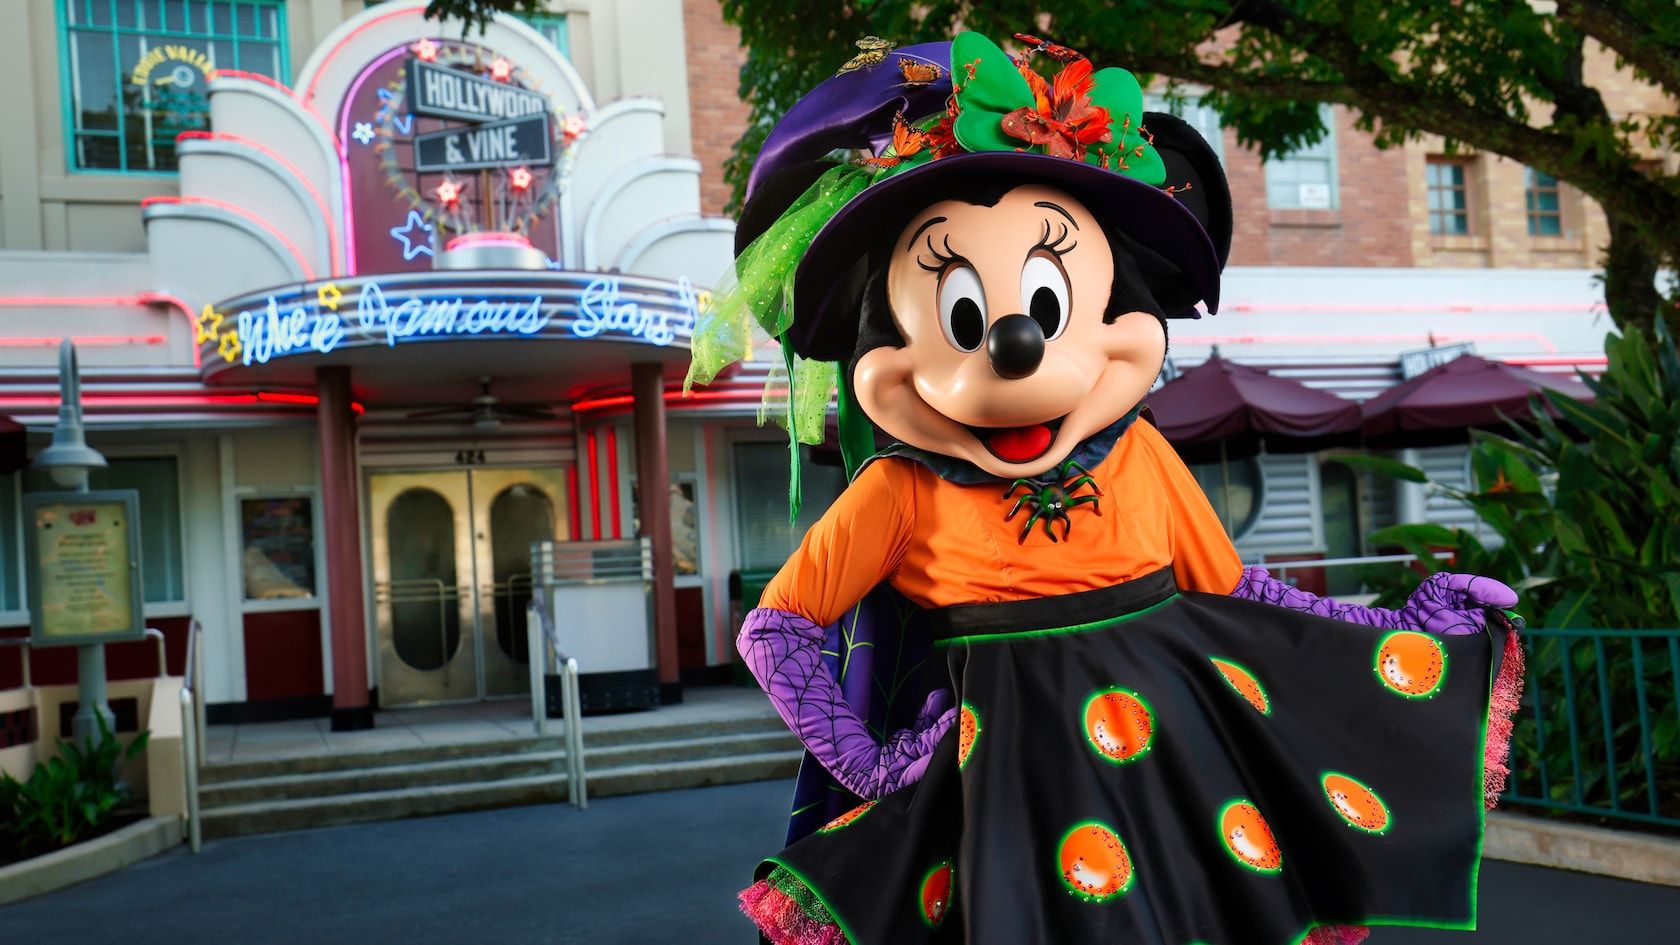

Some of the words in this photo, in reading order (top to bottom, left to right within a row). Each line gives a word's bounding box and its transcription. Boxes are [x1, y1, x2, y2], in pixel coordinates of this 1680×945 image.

[445, 134, 465, 164] &
[467, 125, 519, 162] VINE
[238, 296, 345, 366] Where
[358, 282, 549, 347] Famous
[571, 277, 674, 346] Stars
